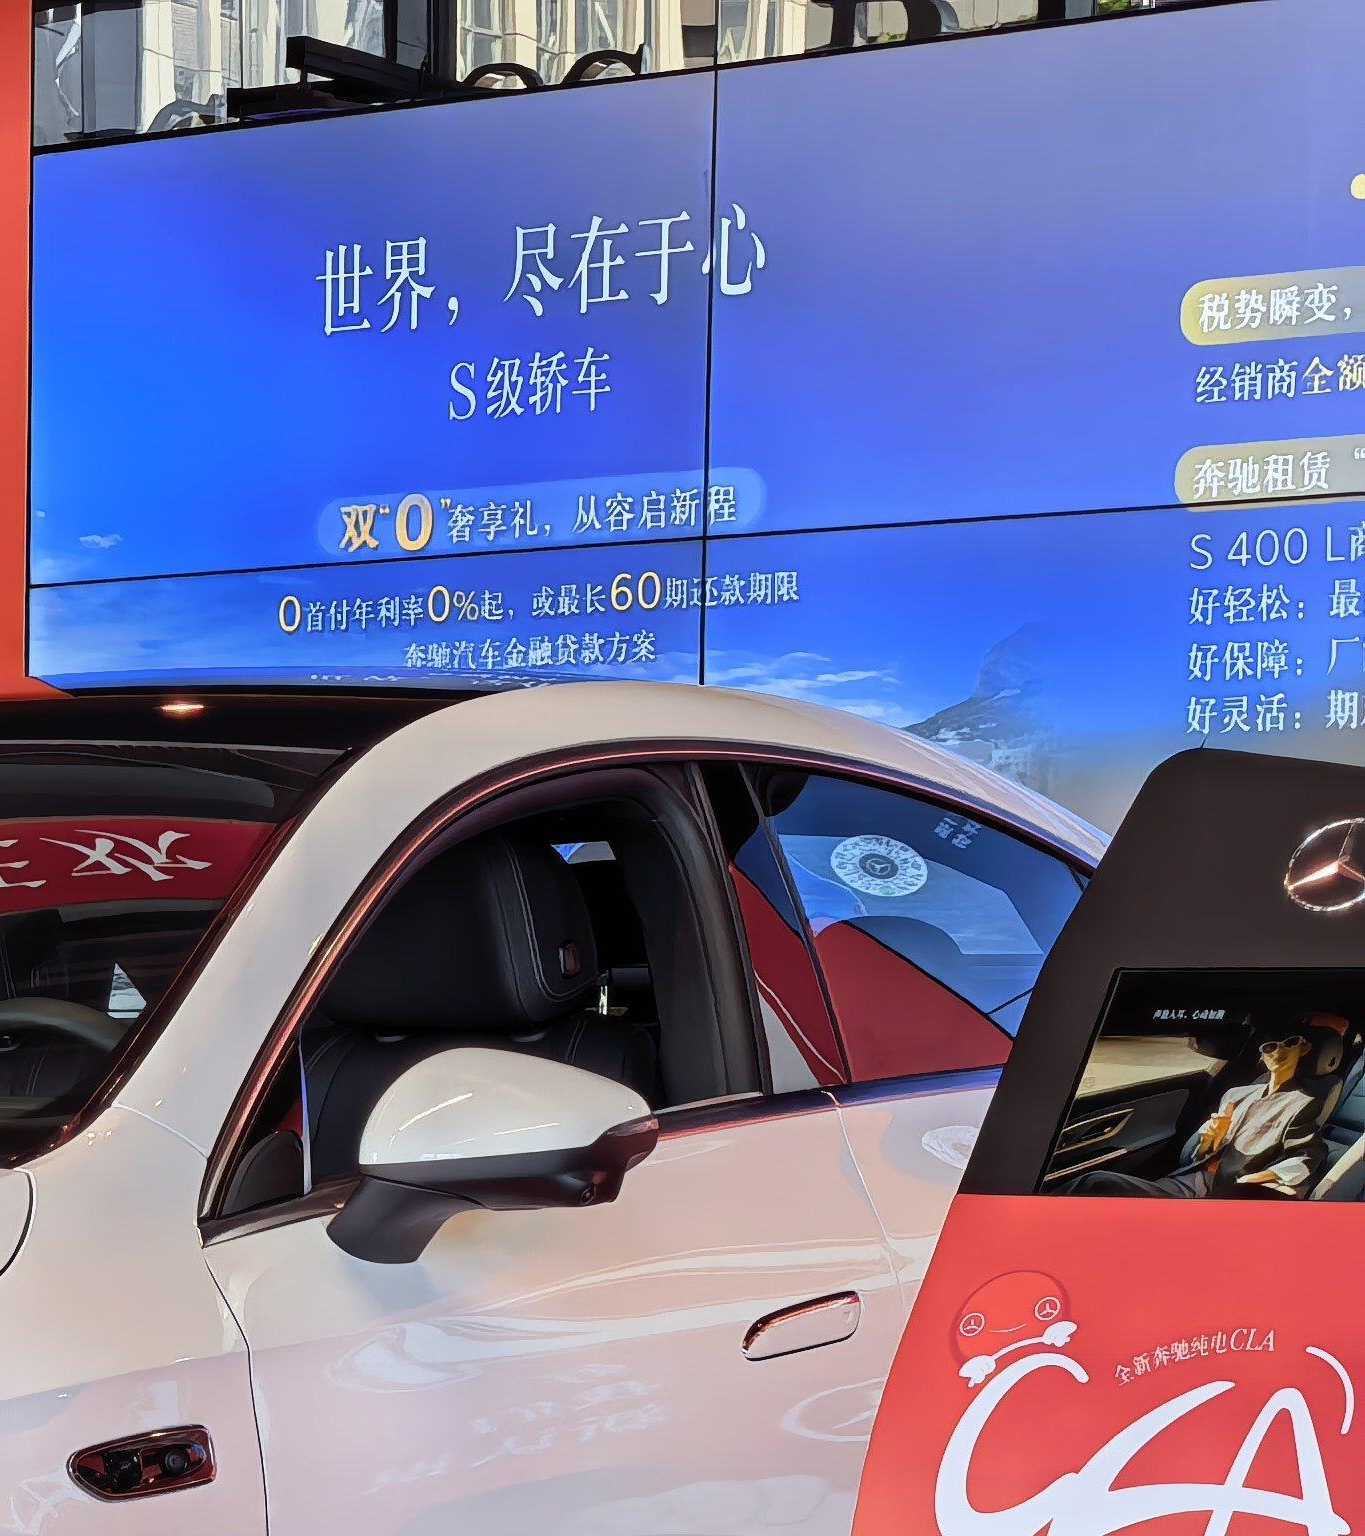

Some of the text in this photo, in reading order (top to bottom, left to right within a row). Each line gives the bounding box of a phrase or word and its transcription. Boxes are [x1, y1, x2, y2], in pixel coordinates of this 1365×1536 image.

[316, 203, 767, 337] 世界，尽在于心
[1227, 527, 1309, 567] 400
[403, 630, 657, 672] 奔驰汽车金融贷款方案
[1187, 636, 1365, 682] 好保障：厂
[1186, 688, 1365, 736] 好灵活：期
[1115, 1327, 1276, 1387] 全新奔驰纯电CLA
